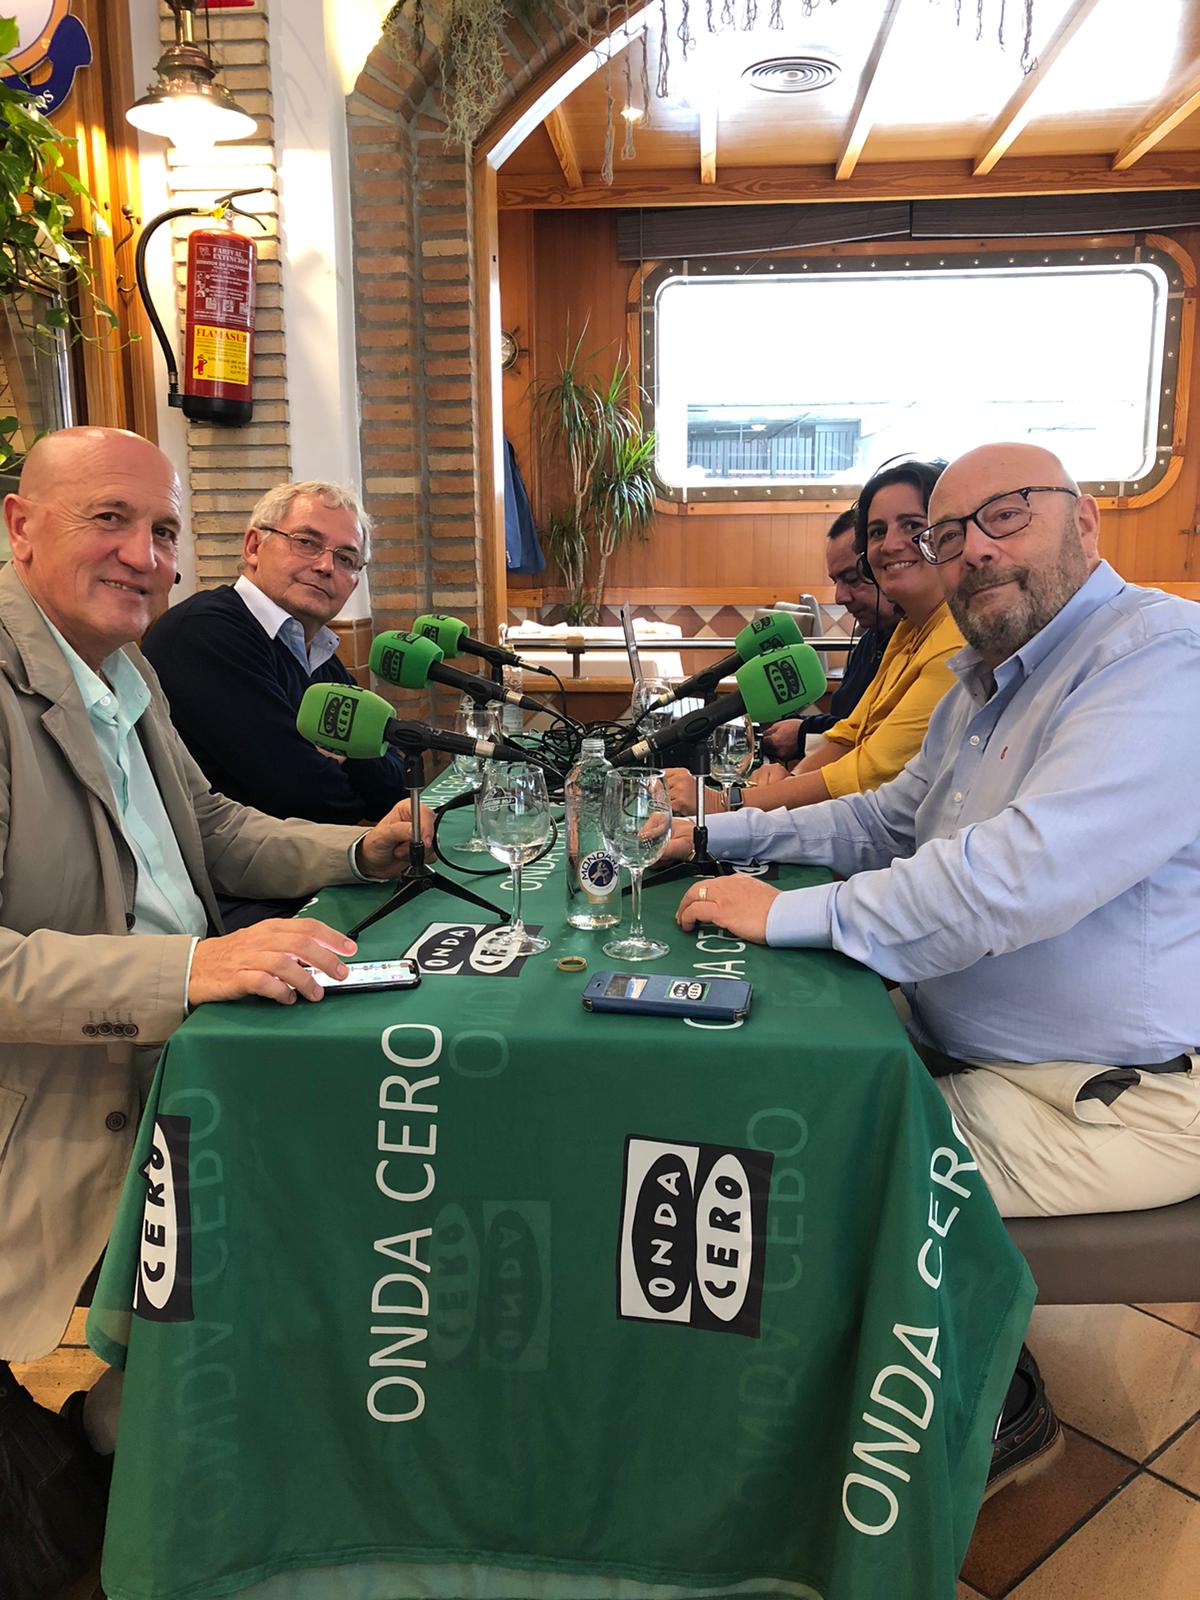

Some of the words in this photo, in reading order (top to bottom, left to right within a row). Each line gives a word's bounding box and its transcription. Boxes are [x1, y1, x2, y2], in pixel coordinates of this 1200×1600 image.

[337, 702, 351, 733] CERO
[424, 929, 470, 967] ONDA
[375, 1022, 443, 1202] CERO
[647, 1170, 682, 1299] ONDA
[703, 1175, 744, 1299] CERO
[367, 1227, 433, 1423] ONDA
[842, 1321, 942, 1536] ONDA
